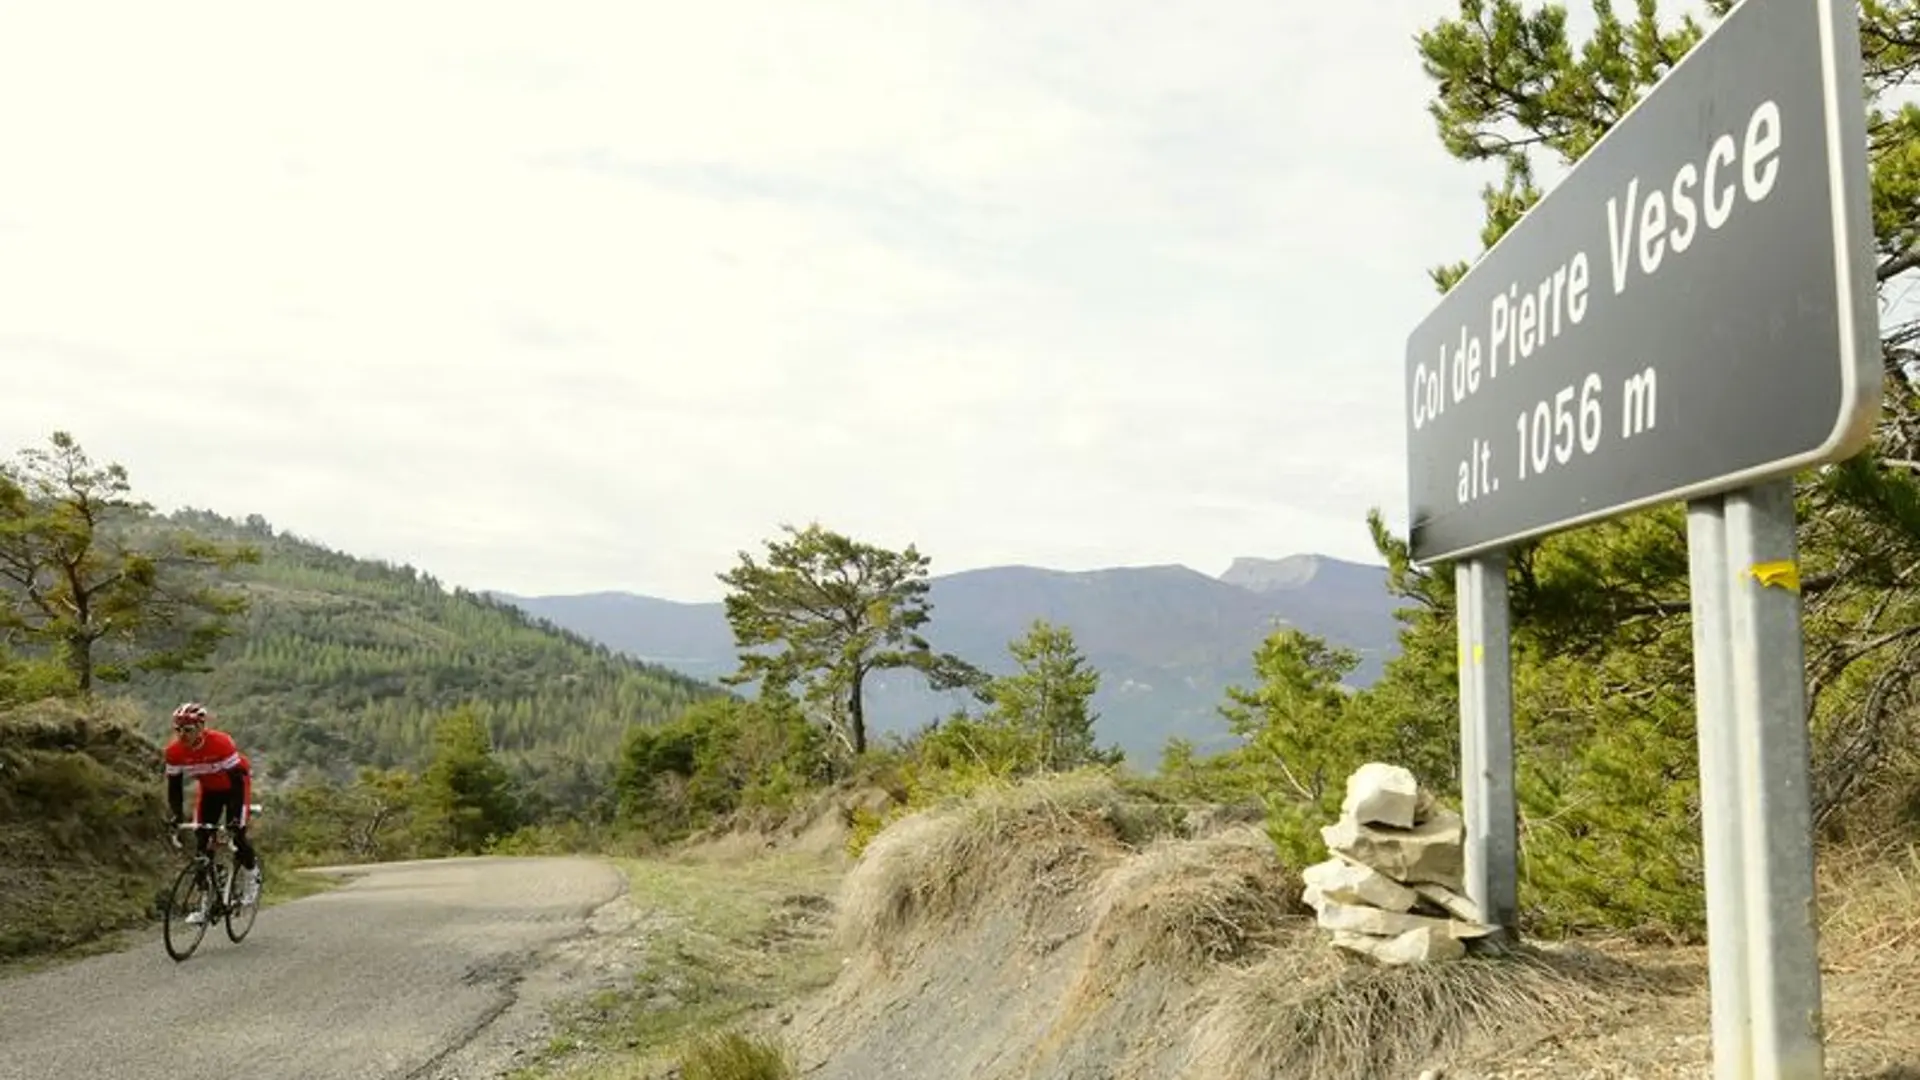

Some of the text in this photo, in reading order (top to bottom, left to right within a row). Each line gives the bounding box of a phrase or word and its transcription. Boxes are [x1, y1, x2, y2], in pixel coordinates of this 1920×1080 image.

[1412, 100, 1782, 430] Col de Pierre Vesce
[1458, 366, 1657, 503] alt. 1056 m
